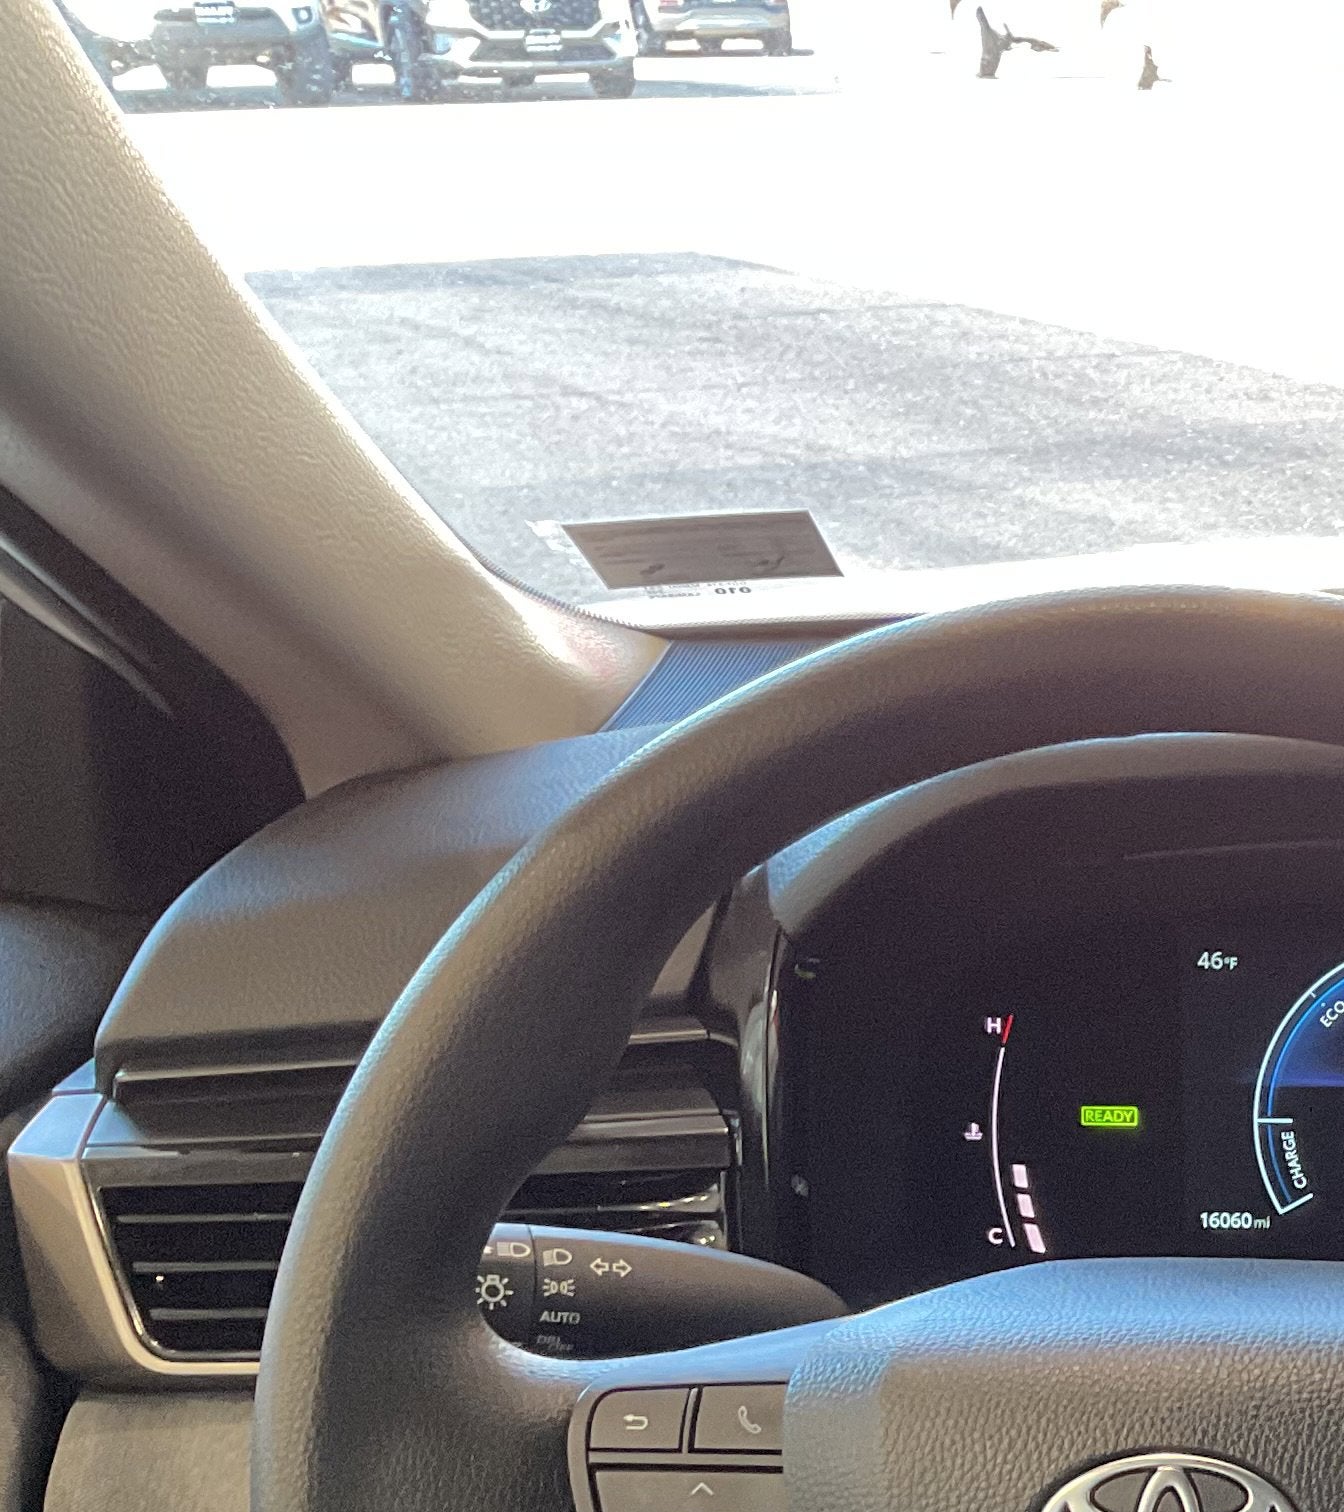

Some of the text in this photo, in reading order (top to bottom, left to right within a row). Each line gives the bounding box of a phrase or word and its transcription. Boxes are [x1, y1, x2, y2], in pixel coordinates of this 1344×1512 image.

[986, 1016, 1002, 1034] H
[1084, 1111, 1135, 1123] READY
[1280, 1130, 1308, 1190] CHARGE
[988, 1227, 1003, 1244] C
[539, 1310, 581, 1325] AUTO
